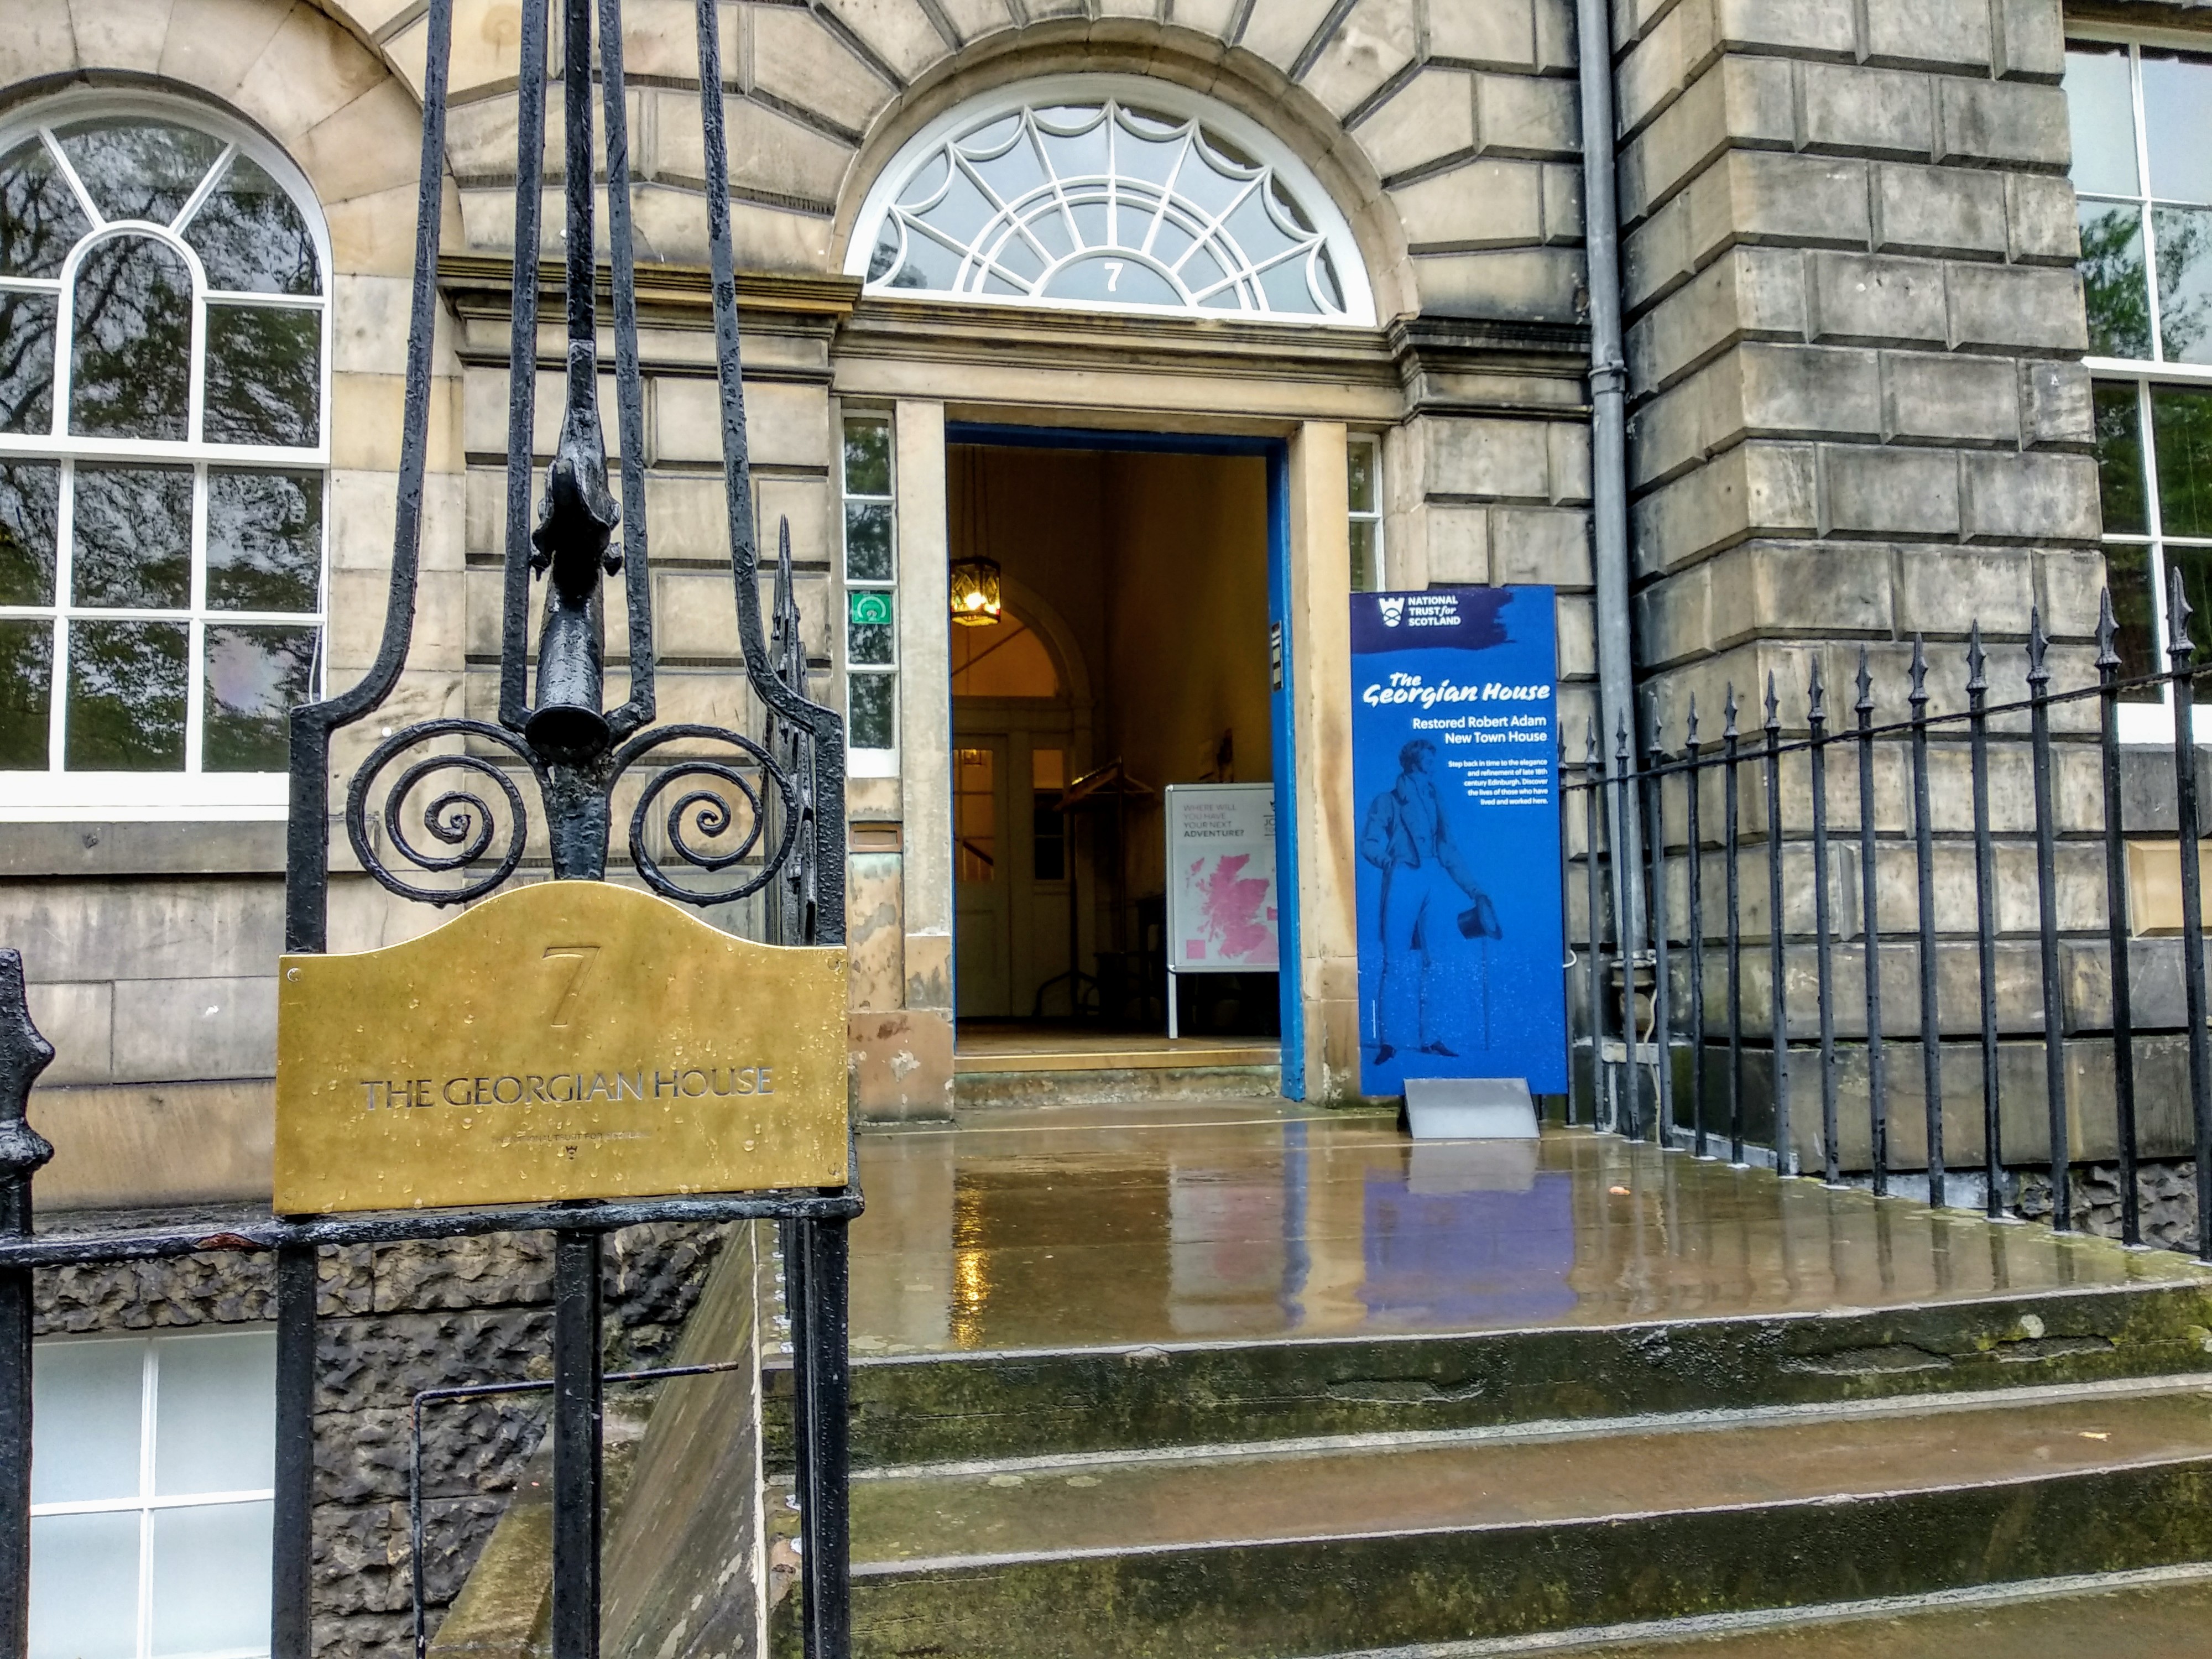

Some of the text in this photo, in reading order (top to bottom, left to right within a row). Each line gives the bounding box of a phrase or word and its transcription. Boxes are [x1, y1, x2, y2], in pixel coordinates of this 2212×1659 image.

[1104, 262, 1124, 292] 7
[1408, 595, 1459, 606] NATIONAL
[1408, 605, 1457, 617] TRUST for
[1408, 615, 1461, 627] SCOTLAND
[1389, 671, 1422, 687] The
[1363, 679, 1551, 710] Georgian House
[1412, 714, 1547, 729] Restored Robert Adam
[1445, 731, 1547, 744] New Town House
[1448, 760, 1463, 769] Step
[542, 946, 602, 1027] 7
[360, 1067, 774, 1110] THE GEORGIAN HOUSE
[509, 1135, 552, 1143] TIONAL
[554, 1133, 582, 1141] TRUST
